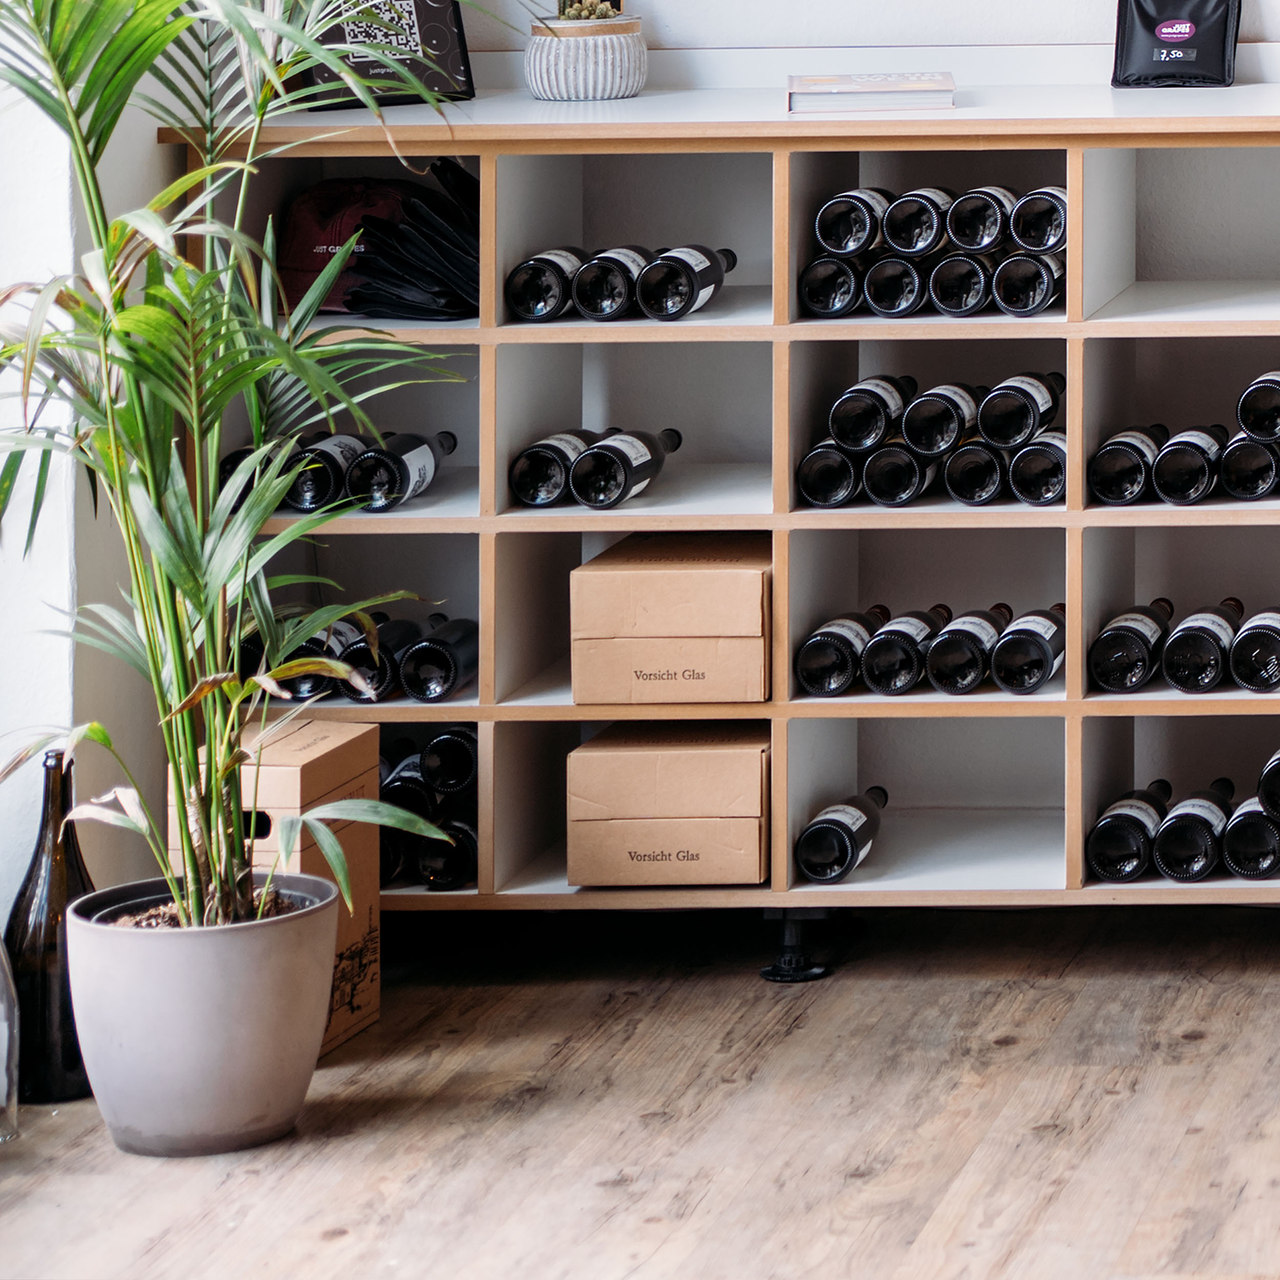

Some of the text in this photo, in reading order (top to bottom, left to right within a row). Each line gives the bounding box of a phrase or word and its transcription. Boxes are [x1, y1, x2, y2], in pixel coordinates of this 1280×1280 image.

[1160, 49, 1184, 61] 7,50
[313, 245, 365, 253] JUST GRES
[633, 668, 706, 682] Vorsicht Glas
[627, 849, 700, 863] Vorsicht Glas
